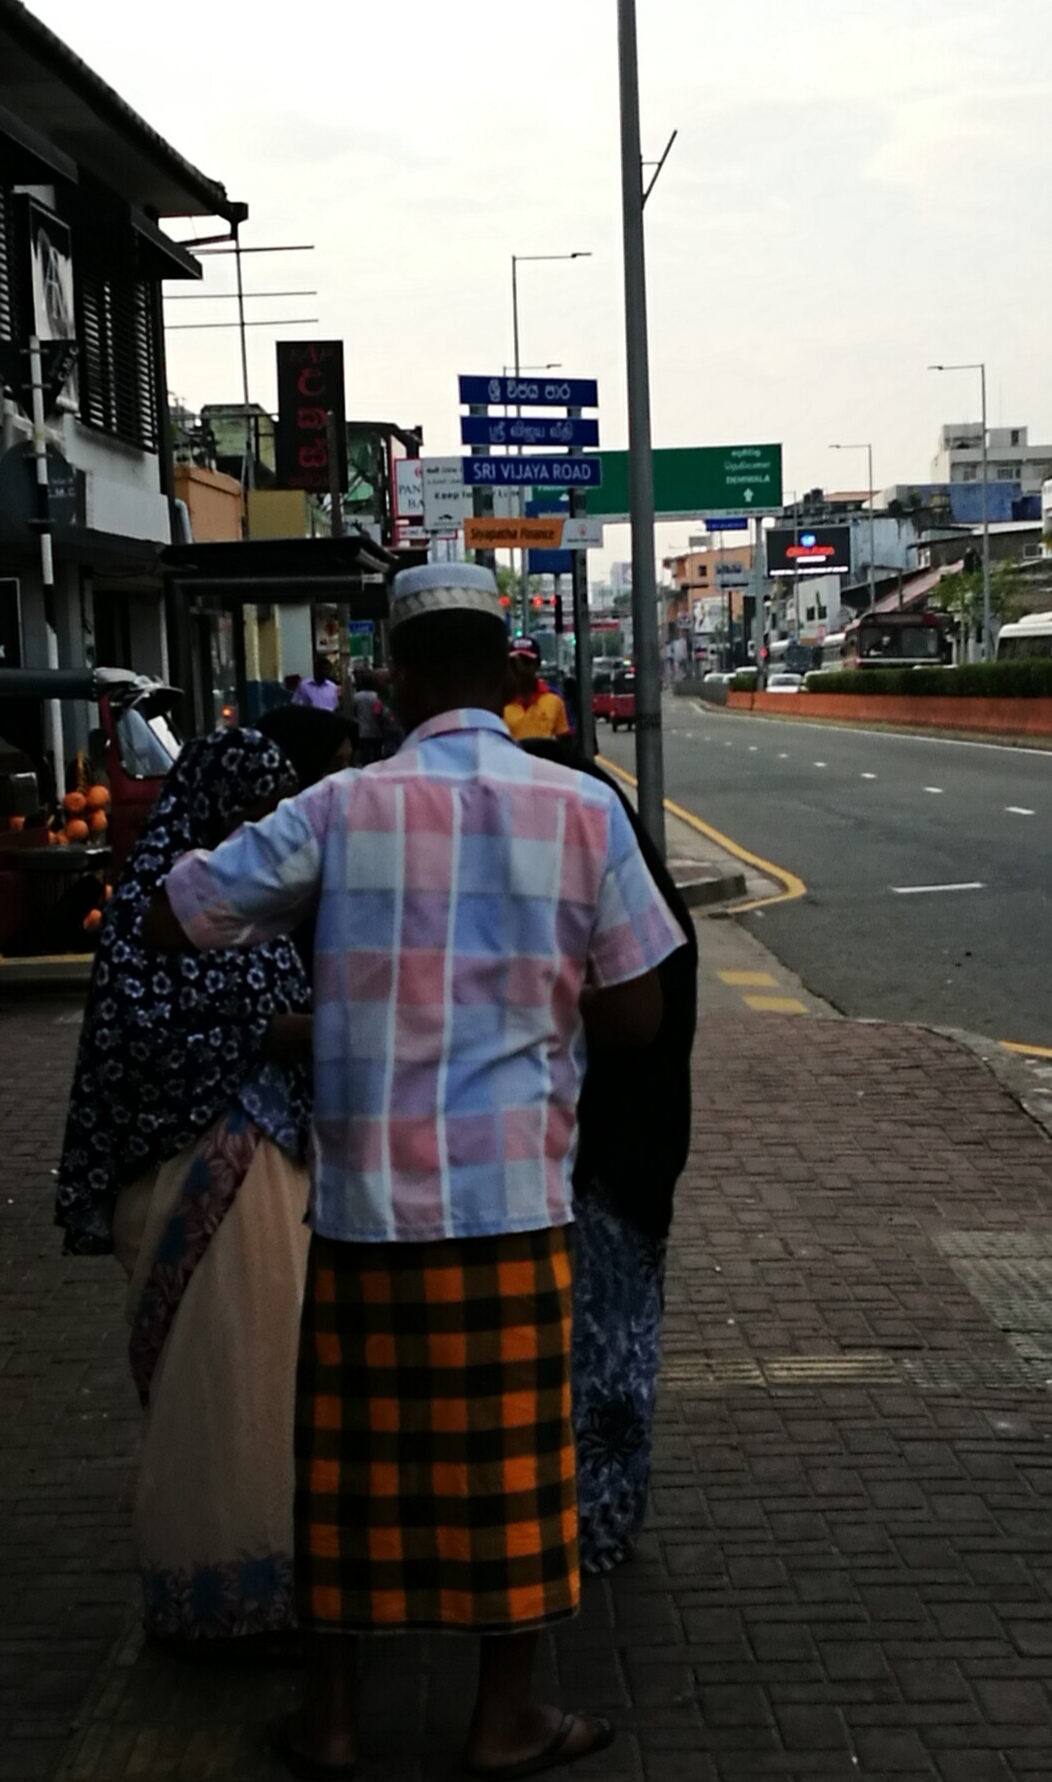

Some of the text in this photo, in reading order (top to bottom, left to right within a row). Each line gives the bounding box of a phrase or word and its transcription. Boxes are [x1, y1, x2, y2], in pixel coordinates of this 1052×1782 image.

[545, 382, 571, 400] පාර
[473, 463, 496, 480] SRI
[500, 463, 549, 480] VIJAYA
[553, 464, 592, 480] ROAD
[520, 527, 555, 541] Finance
